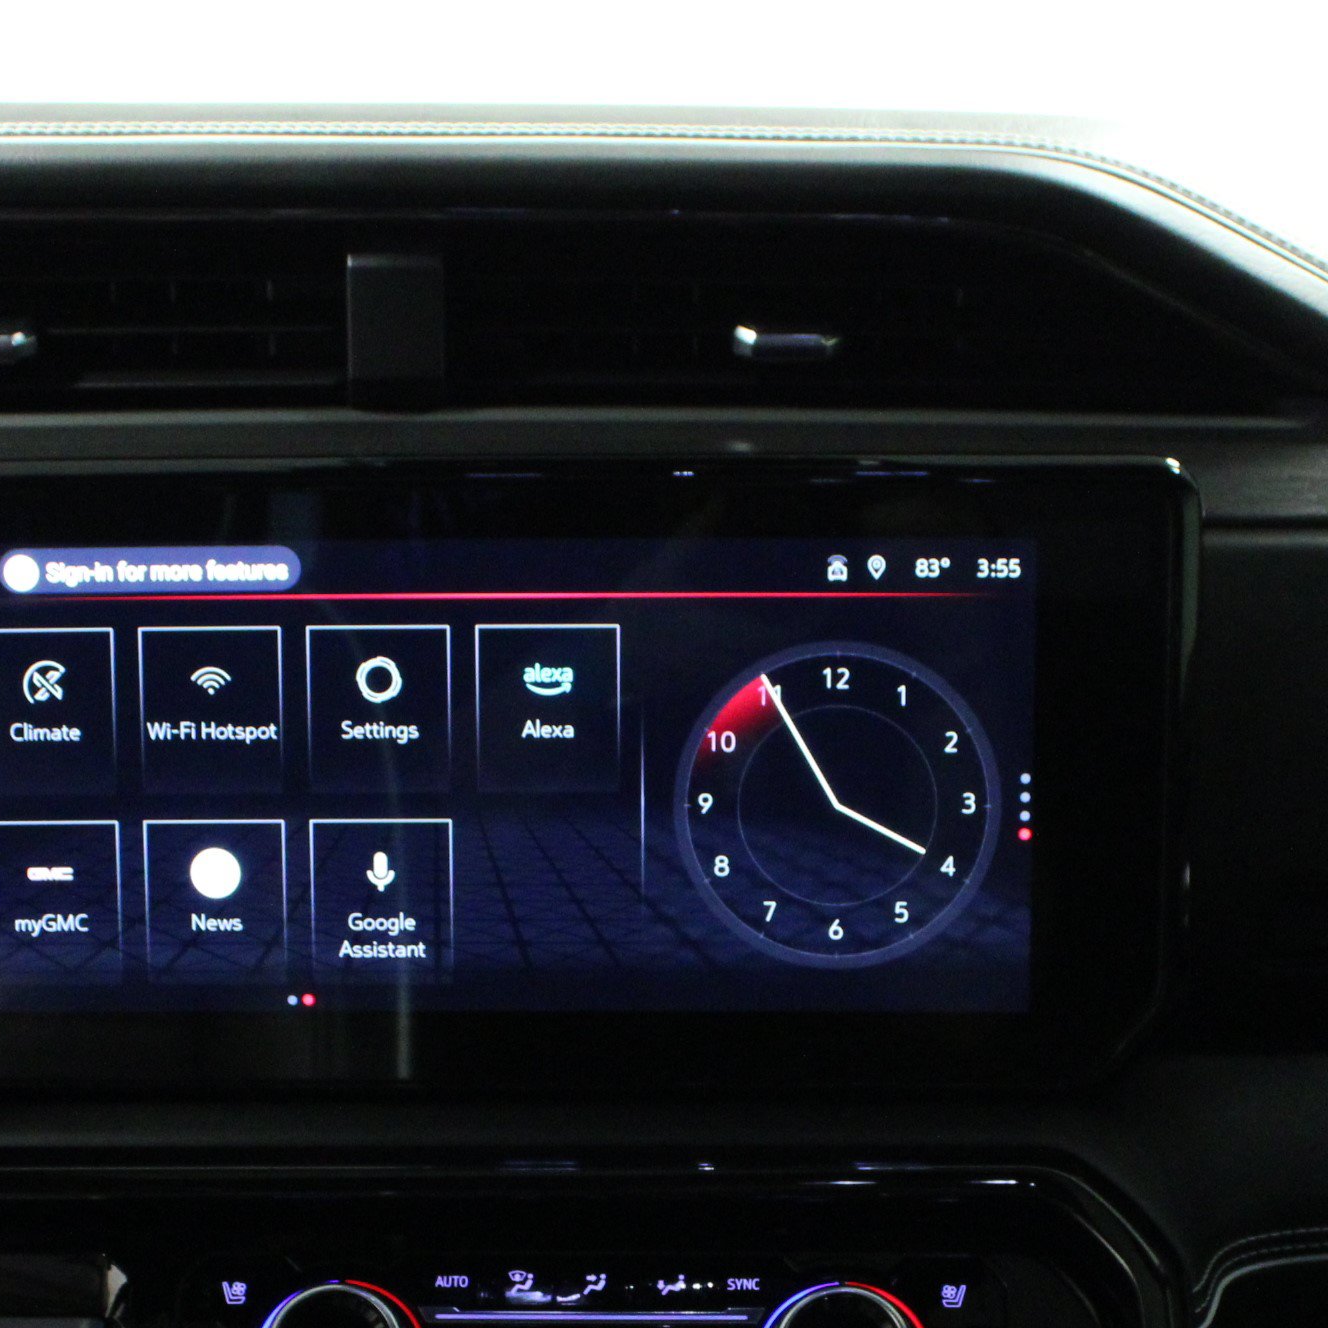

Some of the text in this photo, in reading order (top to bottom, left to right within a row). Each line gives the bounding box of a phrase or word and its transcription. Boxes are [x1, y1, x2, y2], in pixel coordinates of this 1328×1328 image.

[45, 559, 289, 588] Sign-in for more features
[977, 558, 1022, 578] 3:55
[523, 662, 574, 682] alexa
[822, 667, 850, 690] 12
[897, 685, 907, 706] 1
[9, 722, 82, 742] Climate
[147, 721, 278, 745] Wi-Fi Hotspot
[341, 720, 420, 745] Settings
[521, 718, 575, 739] Alexa
[707, 731, 736, 753] 10
[944, 731, 958, 753] 2
[698, 793, 713, 814] 9
[961, 793, 976, 814] 3
[26, 866, 75, 881] GMC
[714, 856, 730, 878] 8
[940, 856, 956, 876] 4
[191, 913, 244, 931] News
[763, 901, 777, 922] 7
[894, 902, 909, 923] 5
[14, 913, 90, 938] myGMC
[347, 912, 417, 936] Google
[829, 919, 844, 940] 6
[338, 939, 427, 959] Assistant
[434, 1275, 469, 1288] AUTO
[727, 1278, 760, 1291] SYNC
